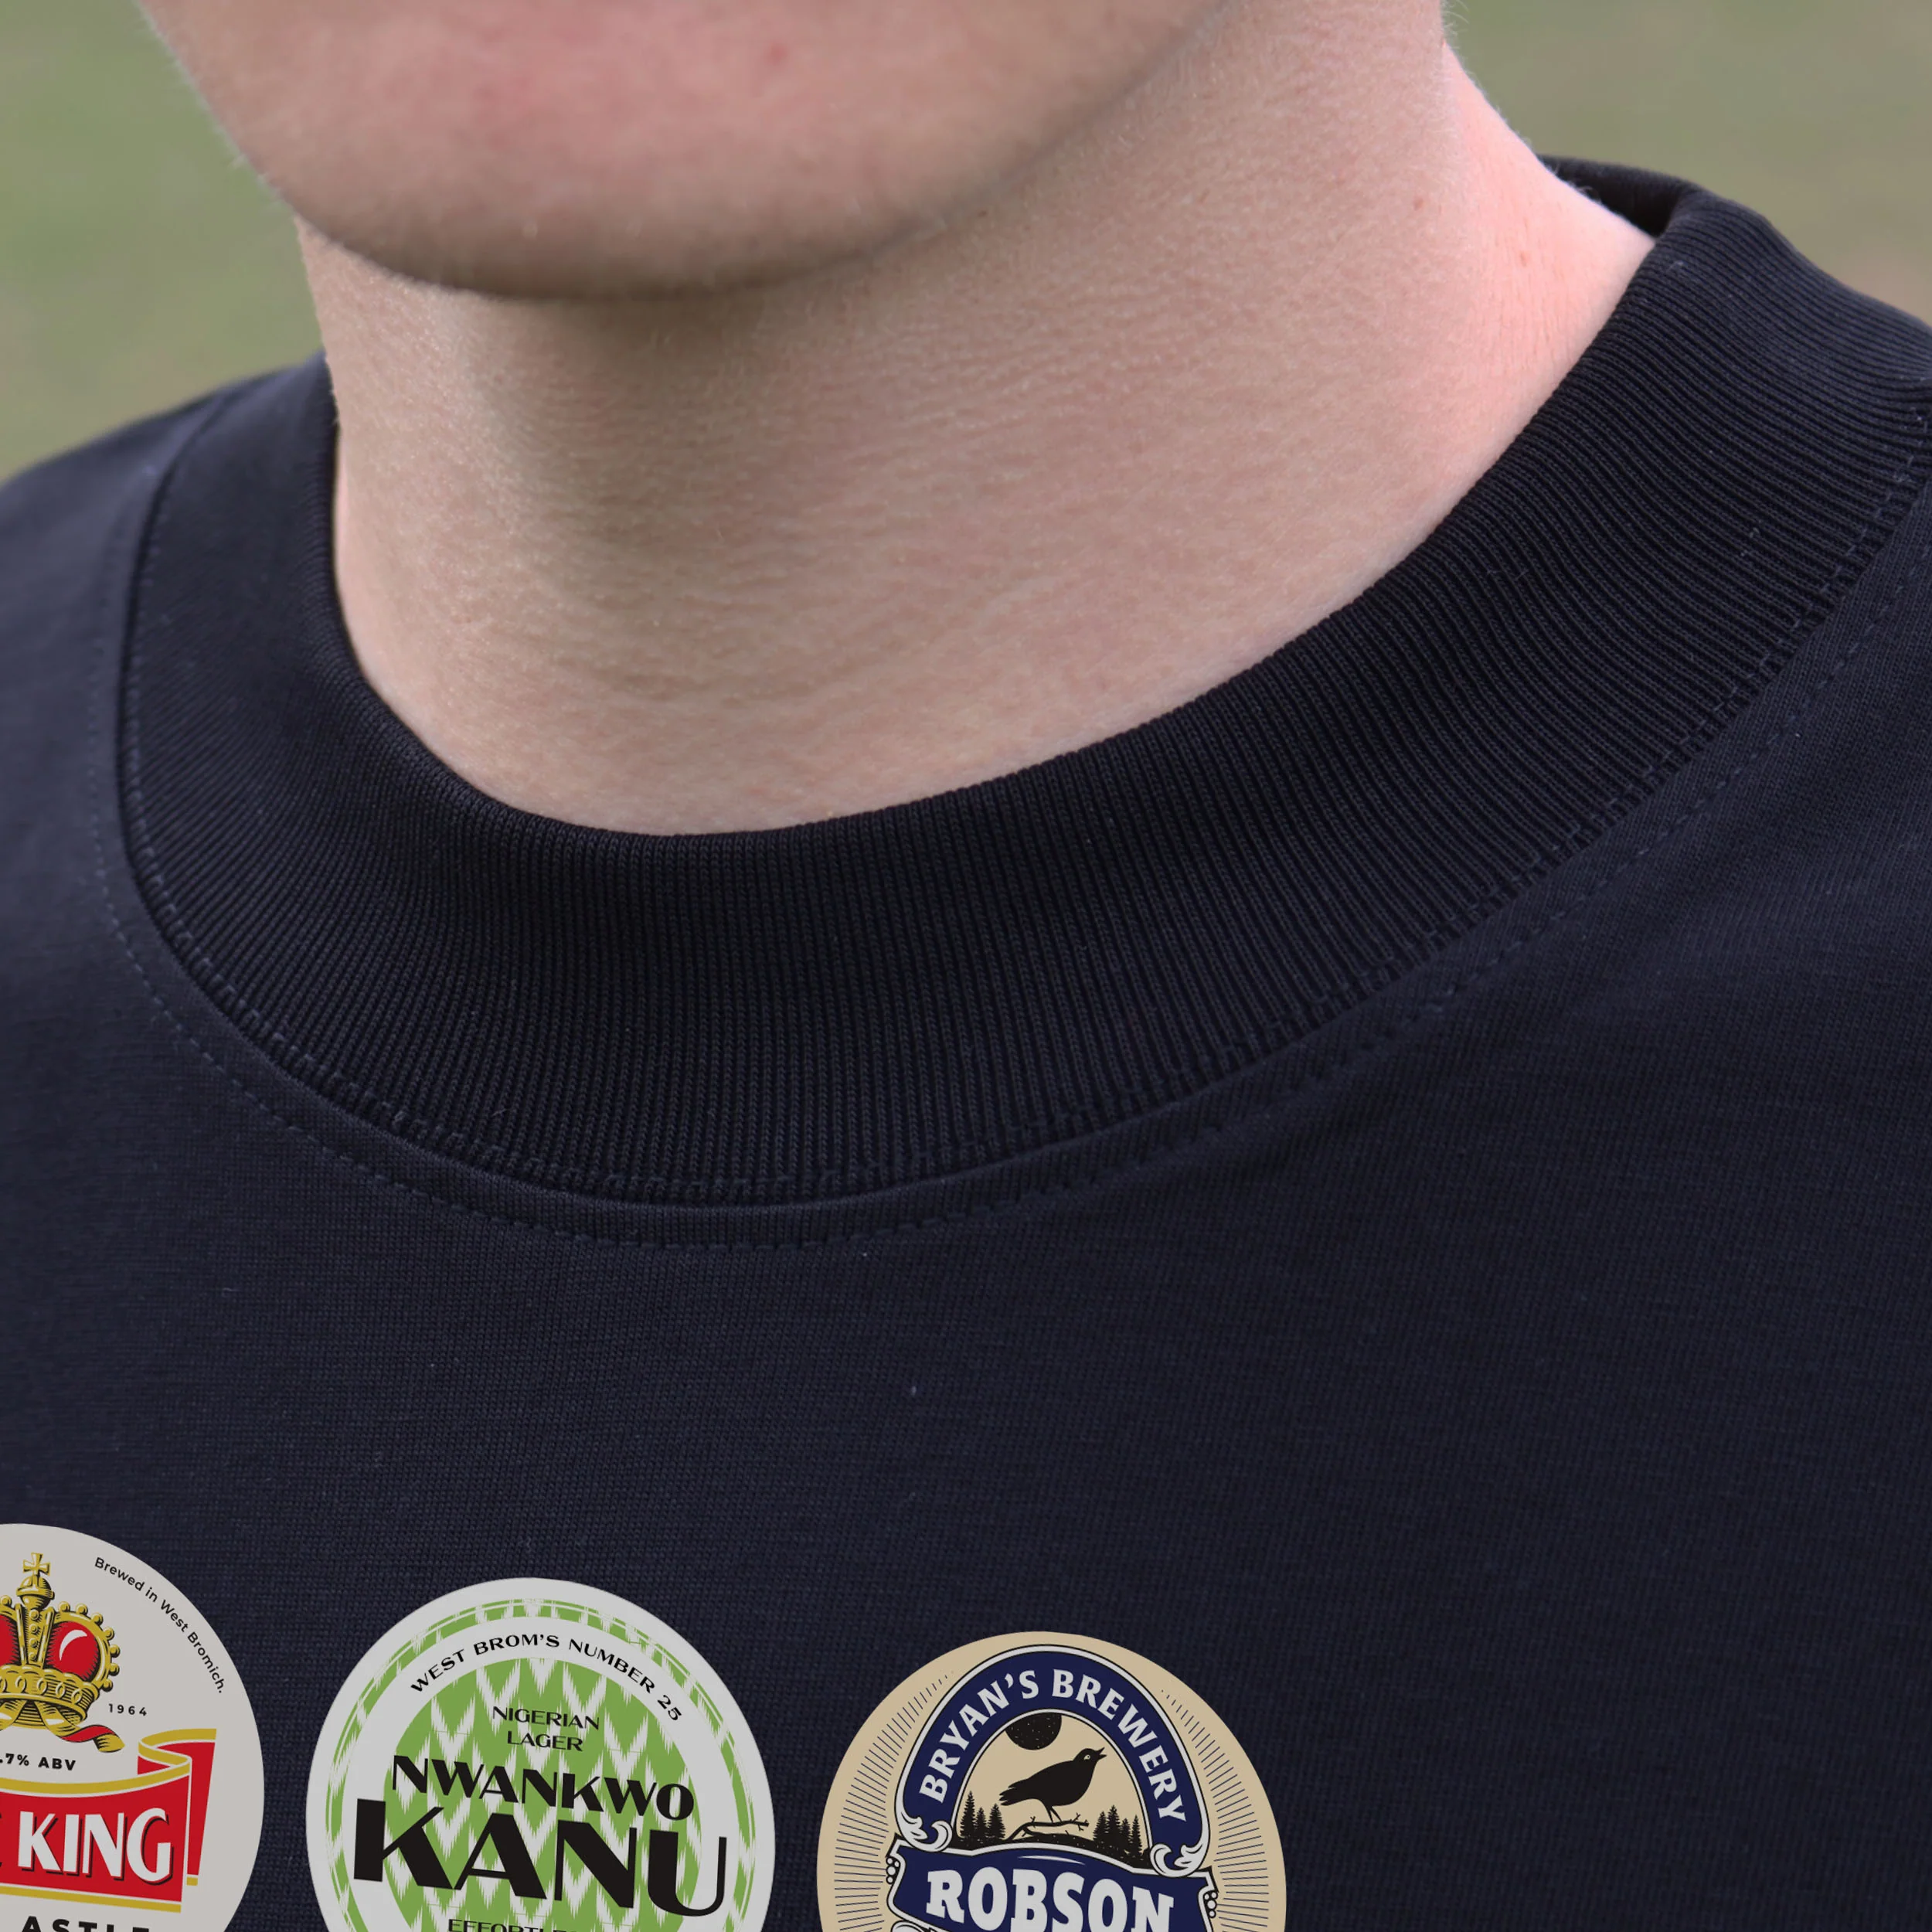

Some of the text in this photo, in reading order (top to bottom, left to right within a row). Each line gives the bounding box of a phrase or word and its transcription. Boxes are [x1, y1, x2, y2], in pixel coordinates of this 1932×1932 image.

[94, 1557, 225, 1694] Brewed in West Bromich.
[109, 1703, 147, 1716] 1964
[410, 1634, 682, 1721] WEST BROM'S NUMBER 25
[492, 1706, 600, 1730] NIGERIAN
[507, 1730, 583, 1752] LAGER
[919, 1668, 1187, 1824] BRYAN'S BREWERY
[39, 1757, 77, 1770] ABV
[393, 1755, 695, 1821] NWANKWO
[18, 1807, 173, 1884] KING
[354, 1798, 727, 1917] KANU
[926, 1866, 1175, 1932] ROBSON
